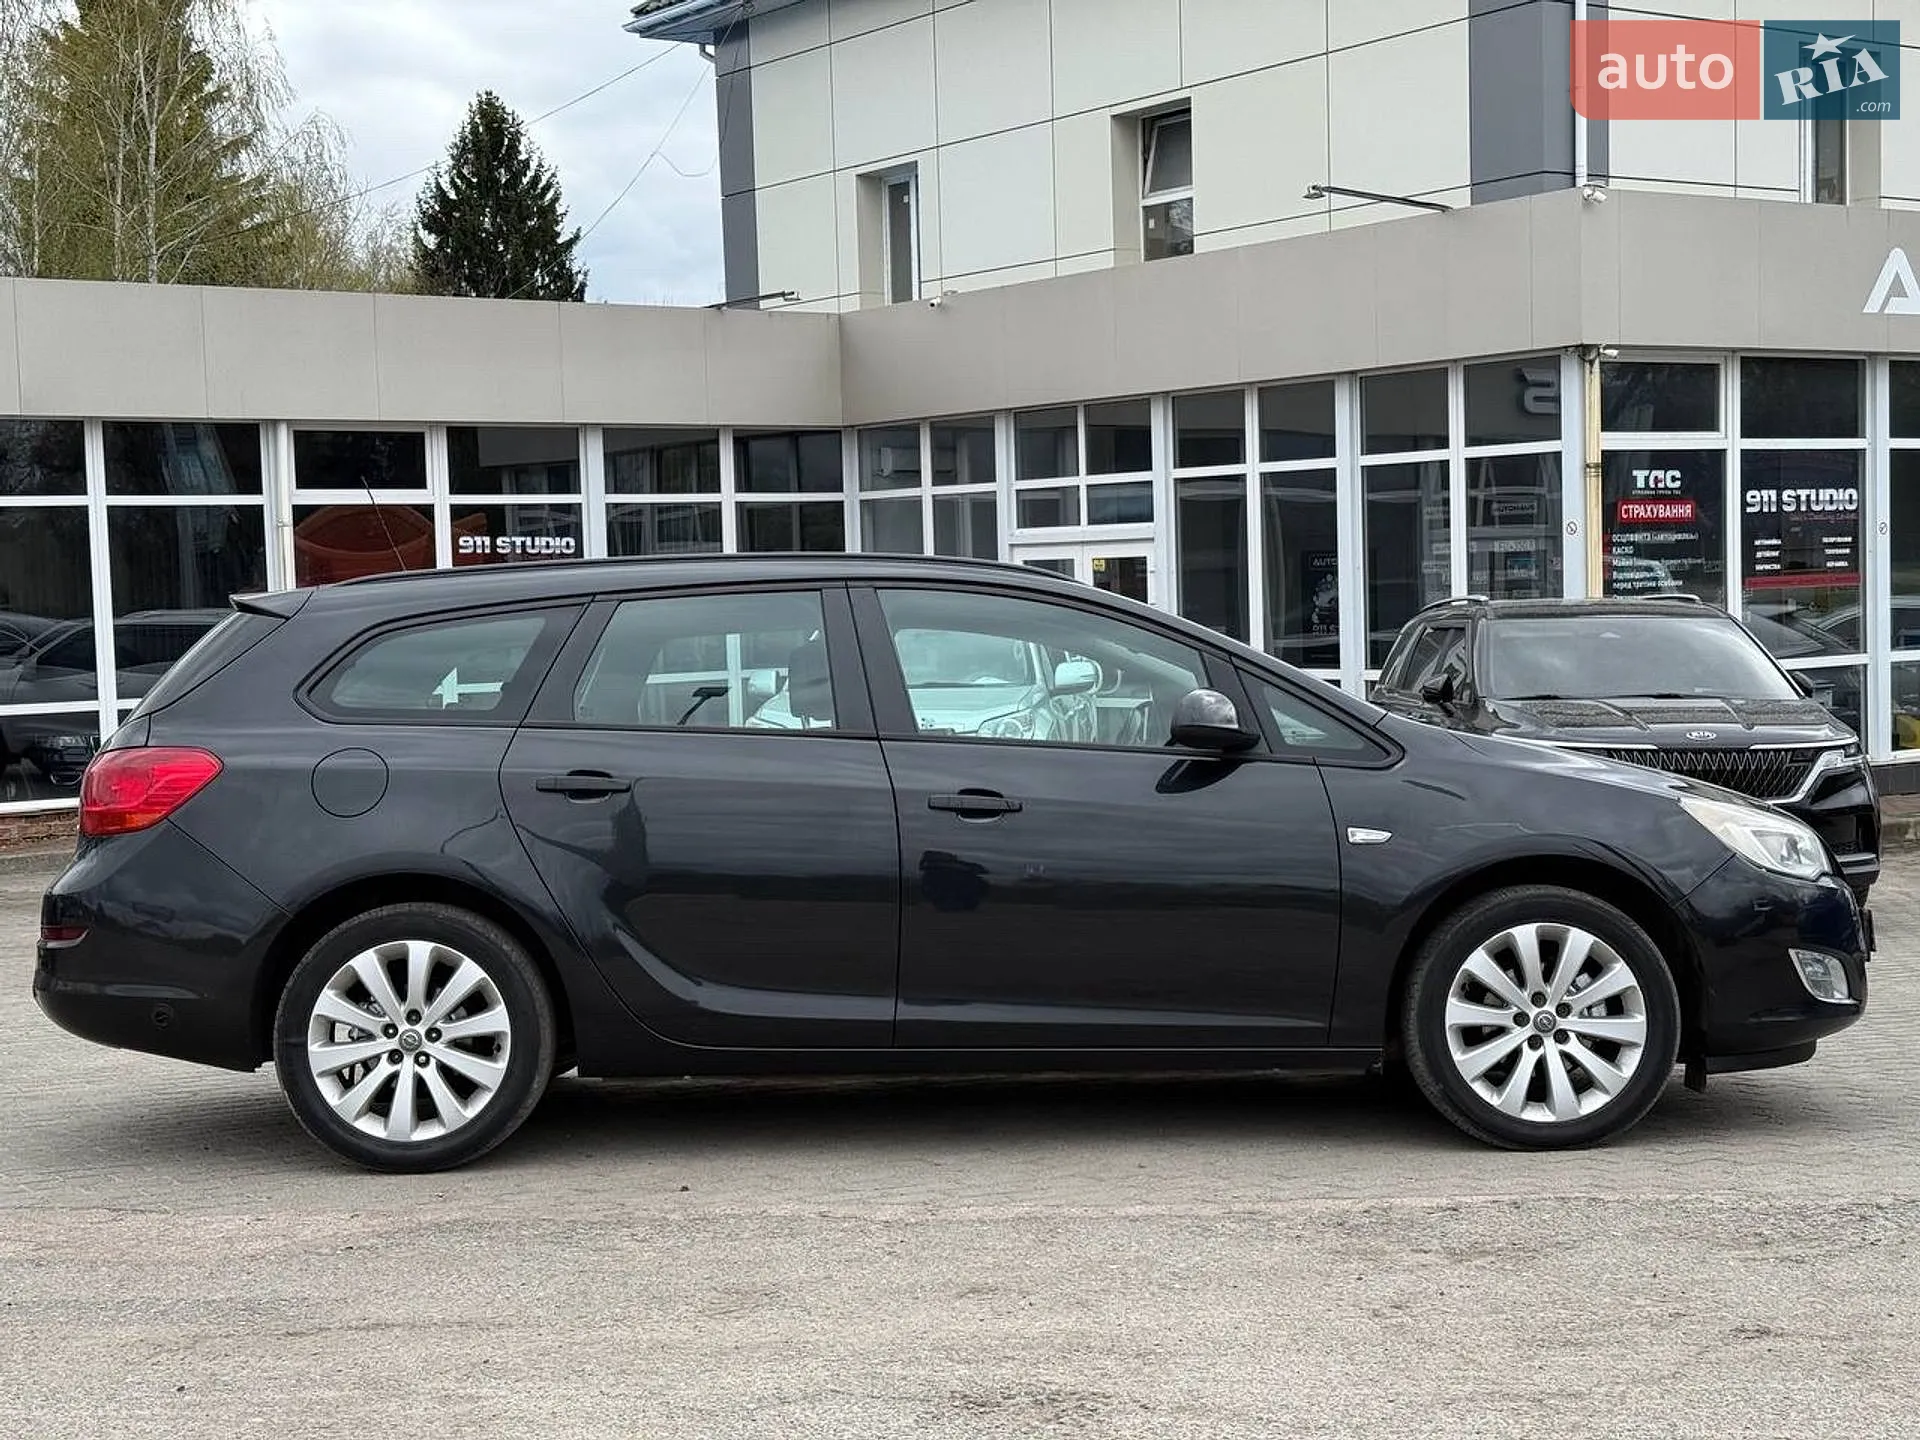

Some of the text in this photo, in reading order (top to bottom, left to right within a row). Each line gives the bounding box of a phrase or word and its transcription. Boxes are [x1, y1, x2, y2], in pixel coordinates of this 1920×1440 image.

[1746, 487, 1858, 513] 911 STUDIO
[1621, 503, 1692, 519] СТРАХУВАННЯ
[458, 535, 576, 555] 911 STUDIO
